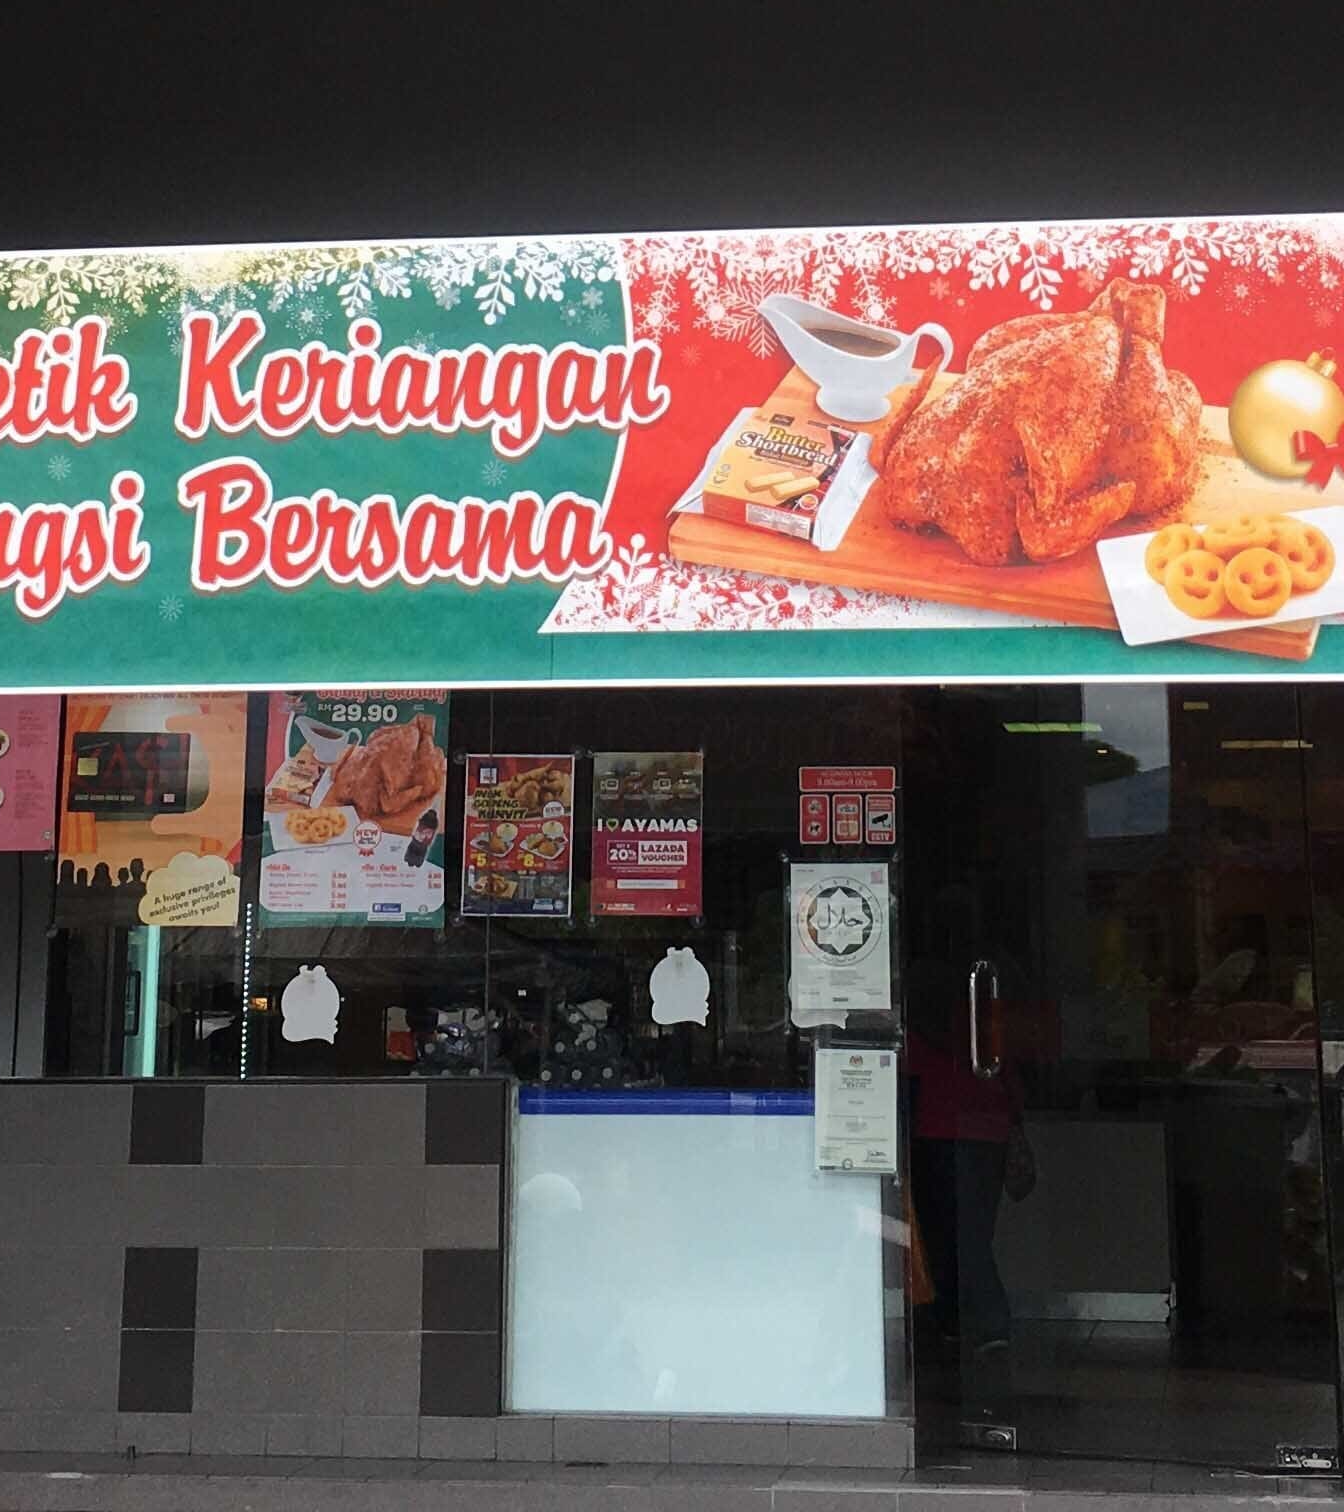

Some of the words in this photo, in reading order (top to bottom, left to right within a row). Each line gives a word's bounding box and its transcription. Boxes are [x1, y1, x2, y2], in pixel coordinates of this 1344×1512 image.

[180, 315, 669, 458] Keriangan
[736, 431, 838, 466] Shortbread
[765, 426, 826, 452] Butter
[182, 457, 614, 592] Bersama
[331, 703, 398, 722] 29.90
[597, 819, 603, 832] I
[622, 818, 698, 832] AYAMAS
[640, 844, 685, 853] LAZADA
[640, 853, 685, 862] VOUCHER
[149, 901, 189, 917] exclusive
[191, 888, 236, 907] privileges
[162, 891, 186, 903] huge
[188, 882, 215, 895] range
[168, 910, 199, 922] awaits
